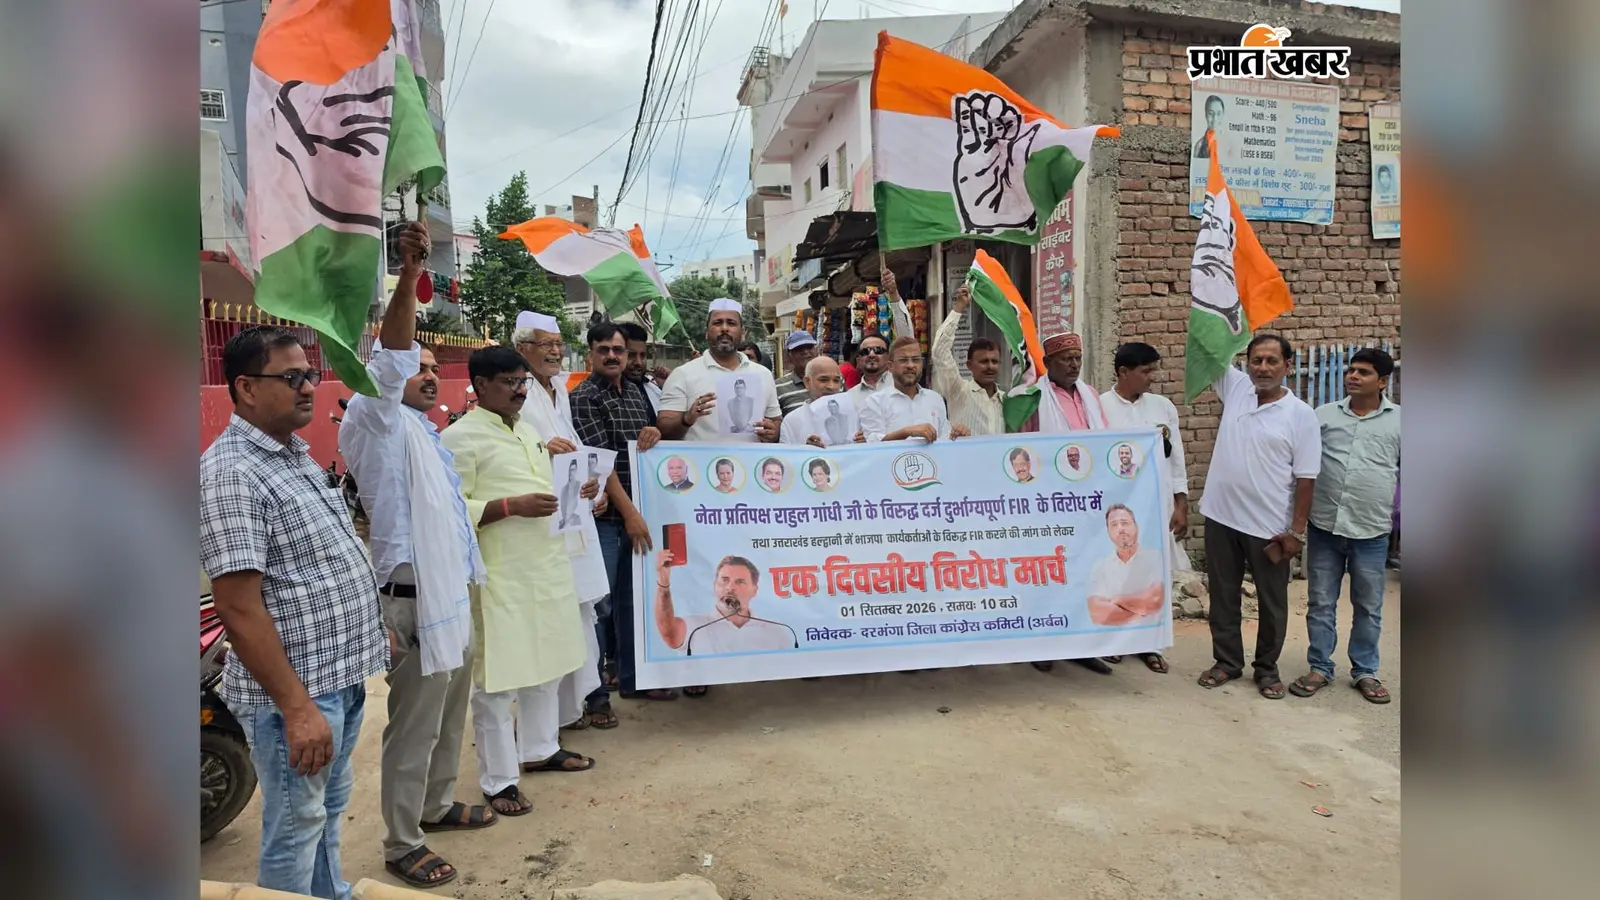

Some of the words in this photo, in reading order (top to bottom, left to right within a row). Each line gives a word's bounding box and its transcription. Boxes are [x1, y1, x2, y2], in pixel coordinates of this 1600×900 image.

[1235, 97, 1250, 107] Score
[1251, 111, 1264, 121] Math
[1295, 114, 1327, 126] Sneha
[1244, 123, 1250, 132] in
[1243, 136, 1277, 146] Mathematics
[1240, 149, 1256, 159] (CBSE
[1261, 150, 1276, 161] BSEB)
[1041, 228, 1072, 250] साईबर
[1045, 251, 1065, 272] कैफे
[694, 504, 722, 525] नेता
[724, 503, 771, 525] प्रतिपक्ष
[773, 507, 809, 528] राहुल
[812, 501, 842, 522] गांधी
[844, 500, 862, 520] जी
[864, 499, 878, 520] के
[880, 498, 919, 520] विरुद्ध
[920, 497, 942, 518] दर्ज
[943, 494, 1006, 523] दुर्भाग्यपूर्ण
[1008, 498, 1030, 515] FIR
[1035, 493, 1049, 513] के
[1051, 492, 1086, 512] विरोध
[1088, 490, 1103, 511] में
[752, 538, 770, 549] तथा
[771, 535, 808, 548] उत्तराखंड
[810, 533, 843, 548] हल्द्वानी
[844, 533, 854, 545] में
[855, 534, 883, 544] भाजपा
[933, 529, 941, 542] के
[969, 530, 984, 541] FIR
[985, 527, 1008, 540] करने
[1008, 526, 1020, 539] की
[1021, 526, 1039, 538] मांग
[1040, 525, 1053, 537] को
[1054, 524, 1075, 537] लेकर
[769, 565, 820, 598] एक
[822, 552, 928, 597] दिवसीय
[930, 550, 1009, 592] विरोध
[1010, 544, 1068, 586] मार्च
[840, 606, 855, 617] 01
[860, 602, 903, 617] सितम्बर
[906, 602, 937, 614] 2026
[980, 598, 997, 611] 10
[999, 595, 1019, 609] बजे
[805, 626, 857, 642] निवेदक-
[860, 622, 904, 639] दरभंगा
[906, 620, 937, 637] जिला
[939, 618, 980, 634] कांग्रेस
[982, 615, 1025, 631] कमिटी
[1027, 613, 1069, 631] (अर्बन)
